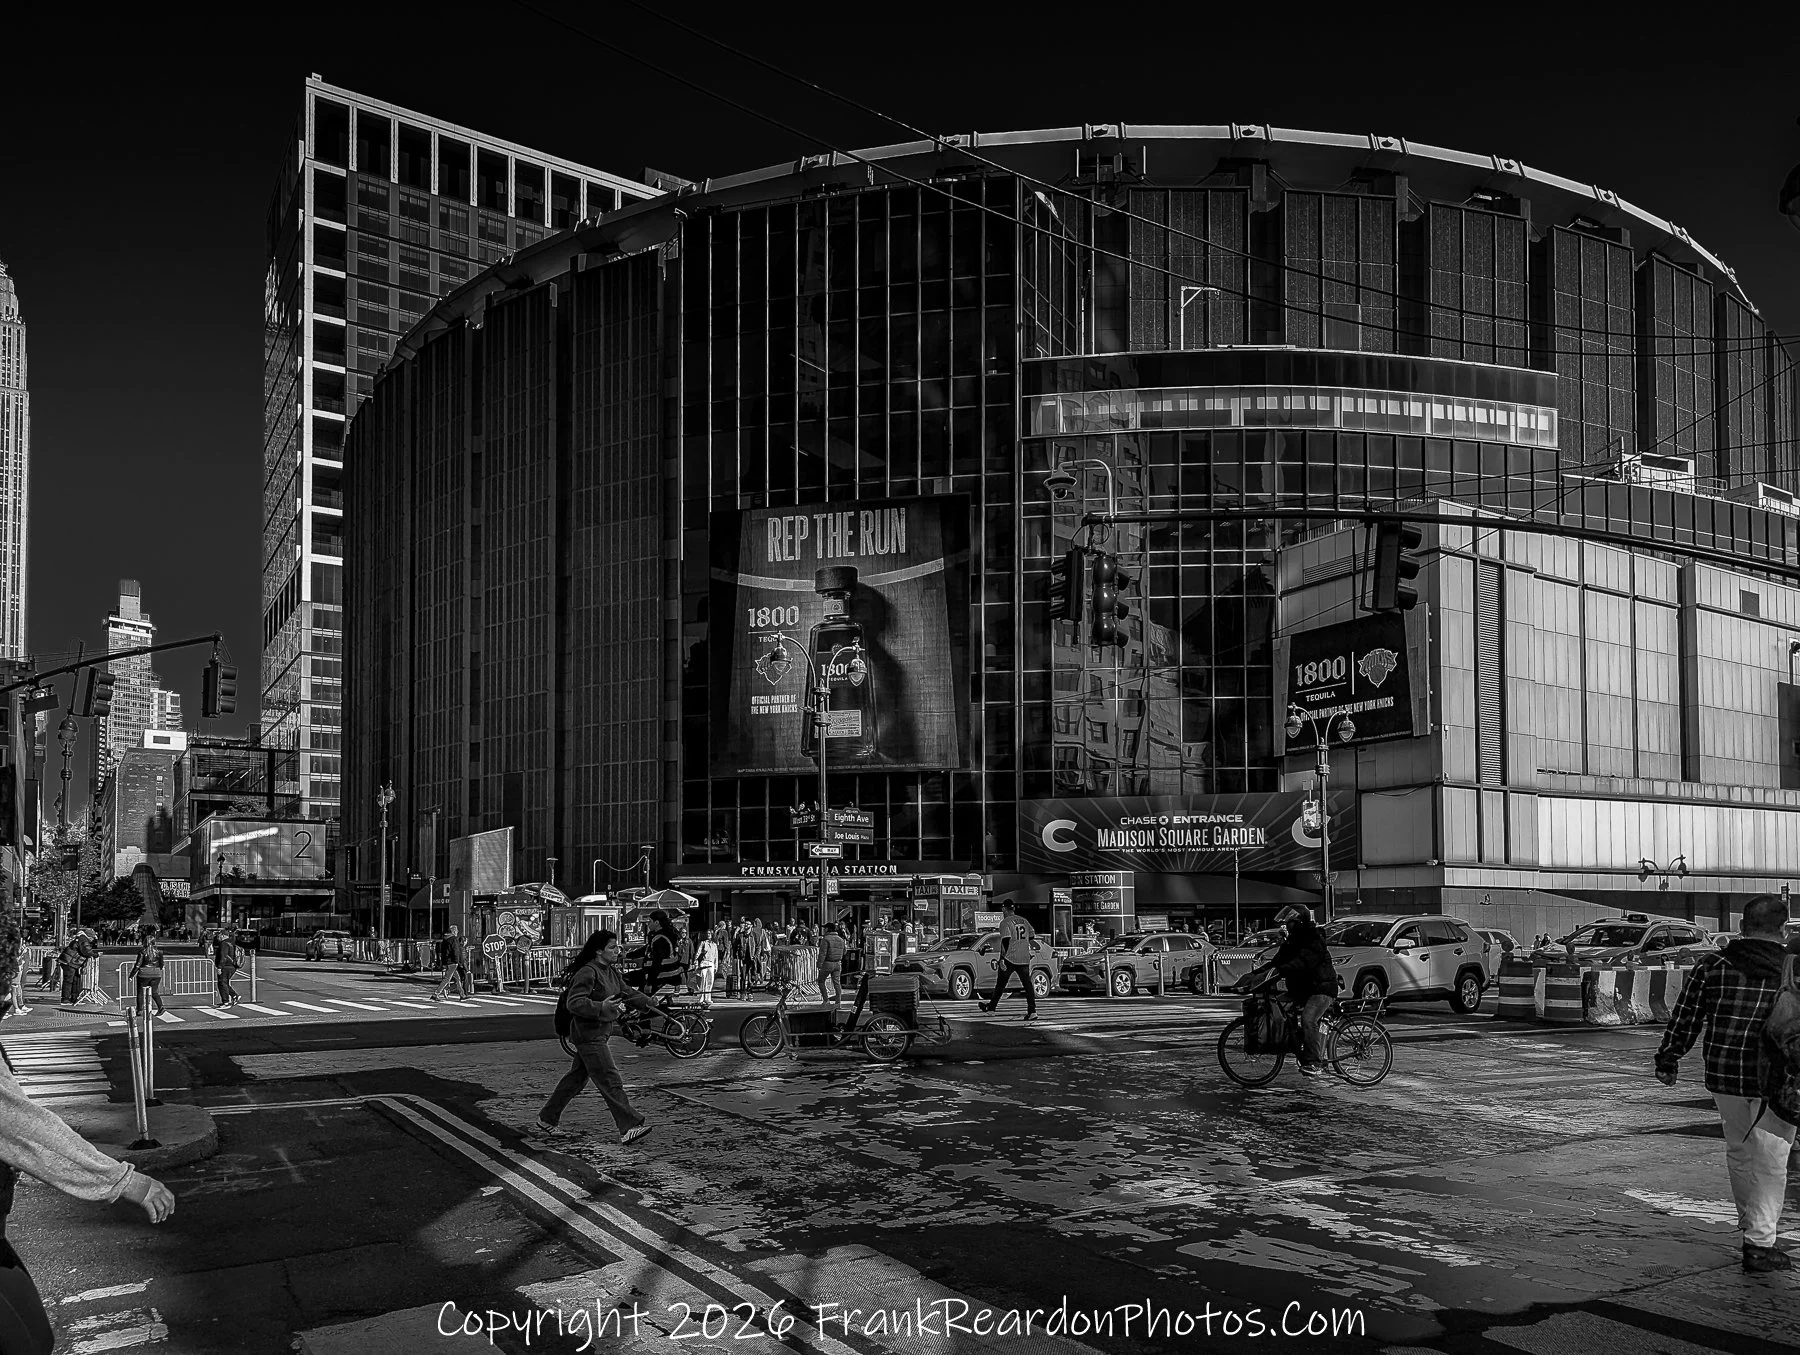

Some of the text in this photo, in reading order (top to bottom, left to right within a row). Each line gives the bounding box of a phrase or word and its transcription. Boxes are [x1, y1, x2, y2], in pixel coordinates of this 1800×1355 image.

[767, 507, 906, 562] REP THE RUN
[748, 605, 800, 628] 1800
[1295, 655, 1346, 687] 1800
[751, 694, 797, 705] OFFICIAL PARTNER OF
[1305, 690, 1336, 702] TEQUILA
[751, 703, 798, 715] THE NEW YORK KNICKS
[1319, 706, 1337, 719] PARTNER
[1353, 701, 1364, 713] NEW
[1364, 699, 1377, 711] YORK
[1377, 696, 1394, 709] KNICKS
[792, 816, 803, 825] West
[834, 813, 869, 823] Eighth Ave
[1120, 814, 1243, 825] CHASE ENTRANCE
[834, 831, 844, 840] Joe
[845, 832, 860, 840] Louis
[1097, 825, 1265, 848] MADISON SQUARE GARDEN
[294, 830, 312, 859] 2
[844, 864, 898, 875] STATION
[1084, 874, 1116, 885] STATION
[915, 886, 931, 894] TAXI
[945, 885, 966, 894] TAXI
[1101, 901, 1120, 910] GARDEN
[1016, 926, 1026, 940] 12
[485, 940, 504, 953] STOP
